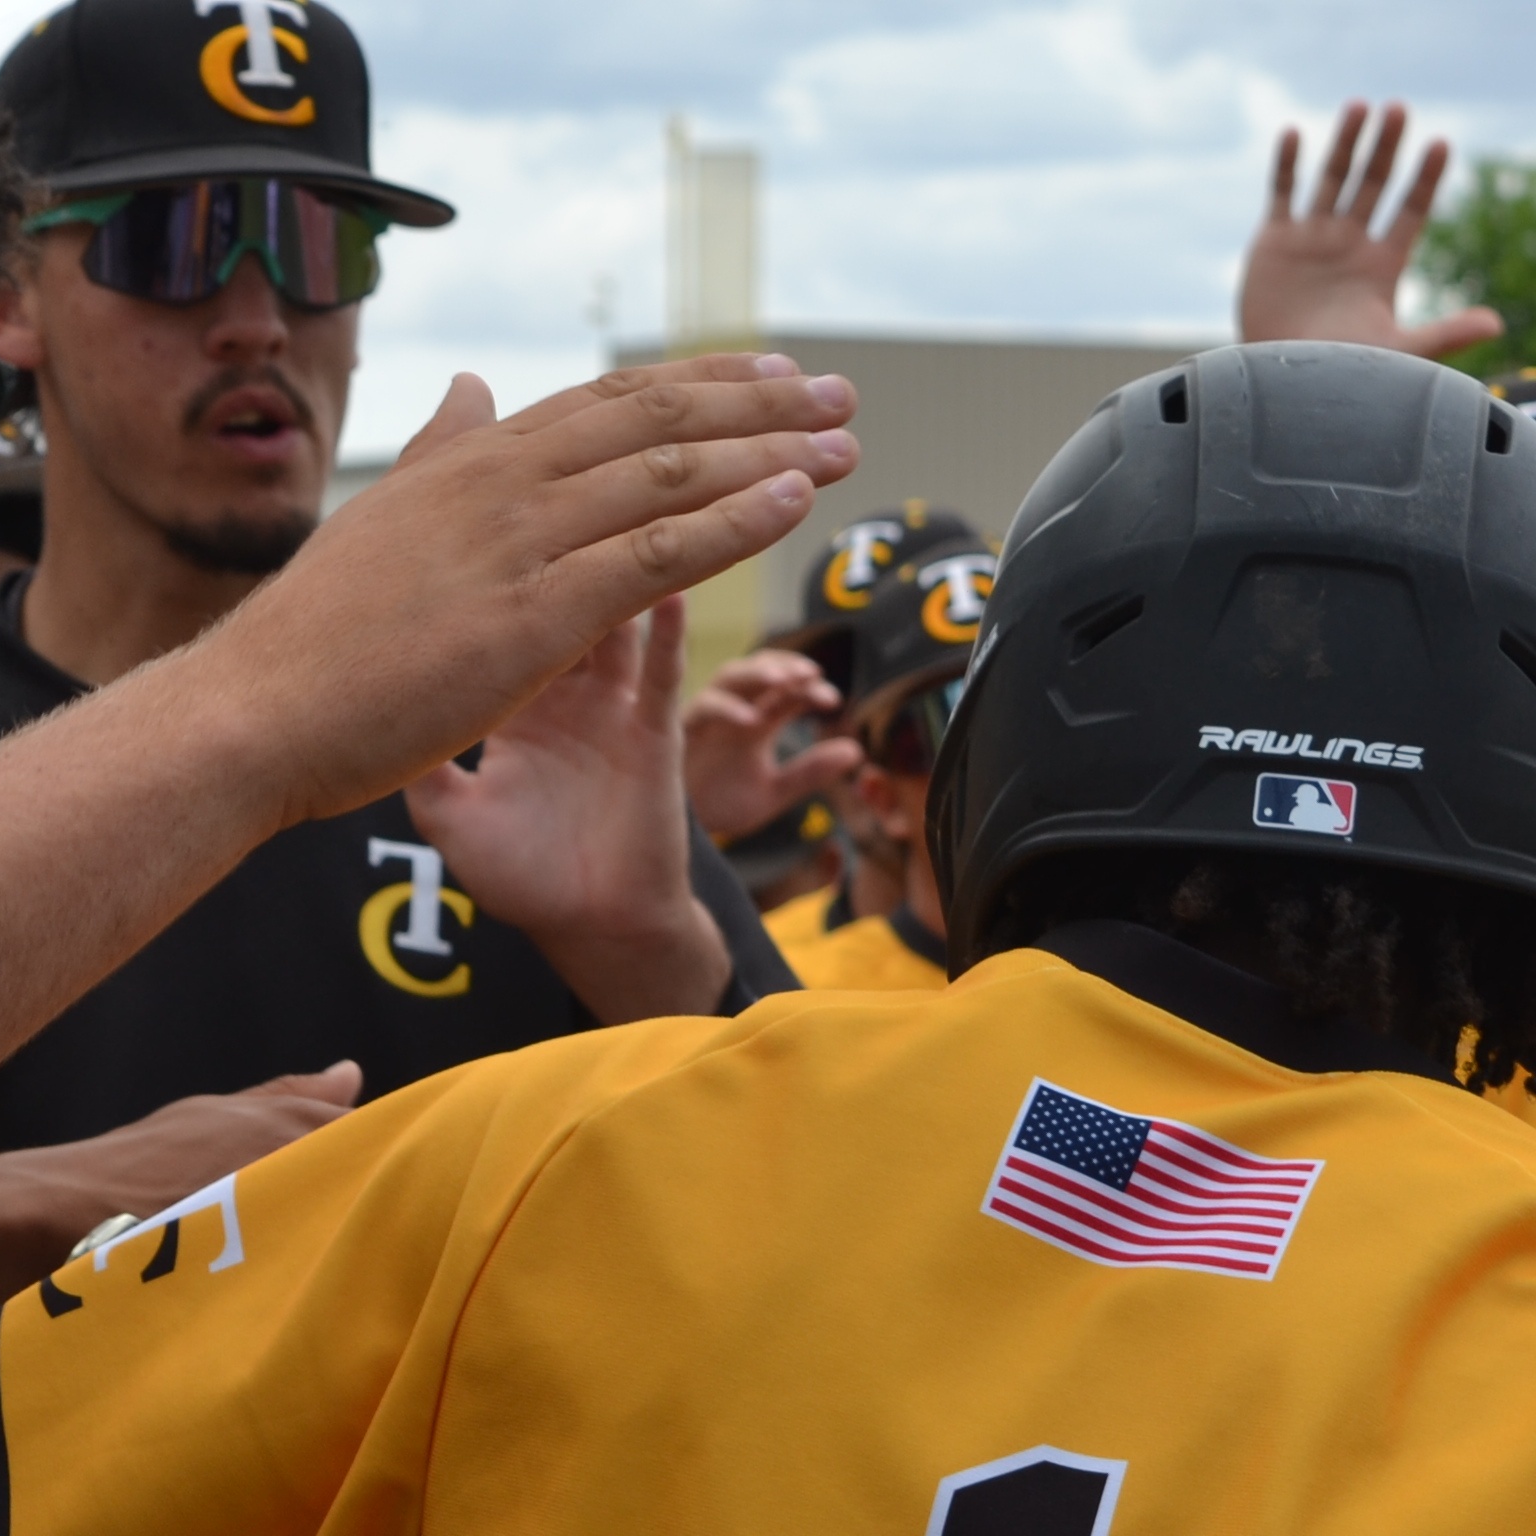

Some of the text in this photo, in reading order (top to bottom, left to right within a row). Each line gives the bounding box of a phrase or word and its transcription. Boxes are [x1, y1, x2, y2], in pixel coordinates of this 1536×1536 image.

[195, 0, 317, 127] TC
[1198, 725, 1424, 770] RAWLINGS
[358, 837, 474, 997] TC
